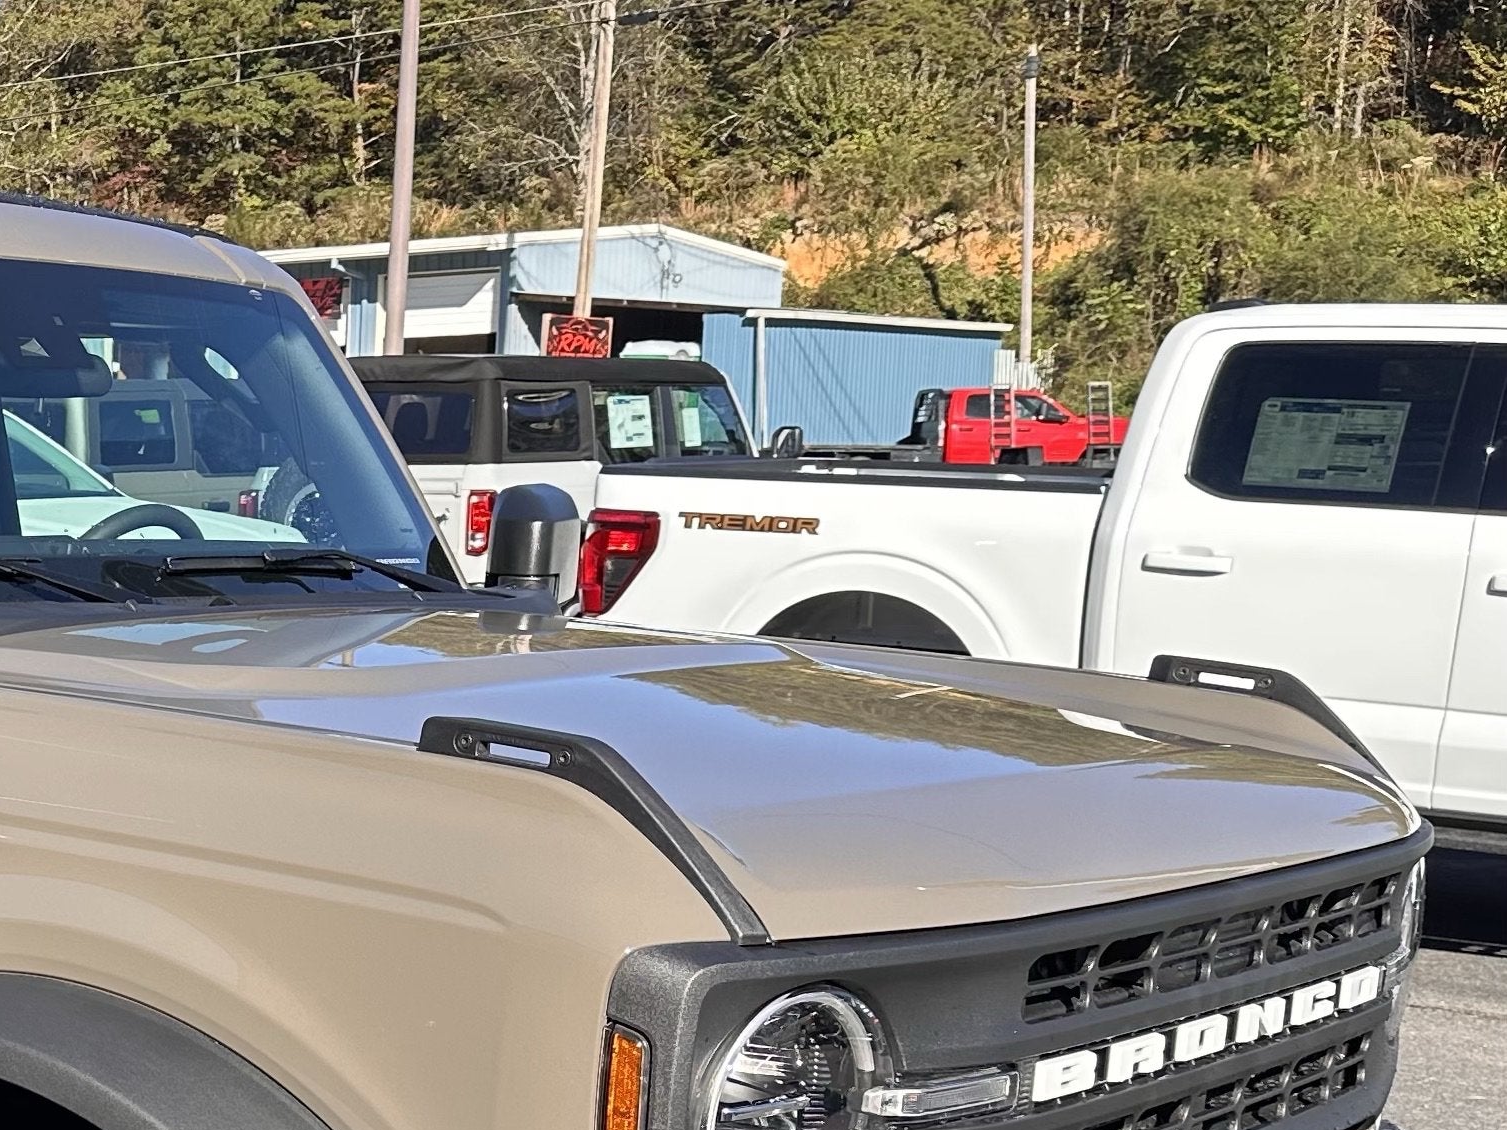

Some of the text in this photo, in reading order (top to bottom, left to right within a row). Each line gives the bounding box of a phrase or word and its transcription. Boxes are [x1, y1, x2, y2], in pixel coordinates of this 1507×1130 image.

[557, 333, 597, 353] RPM
[678, 511, 820, 536] TREMOR
[1031, 965, 1380, 1102] BRONCO
